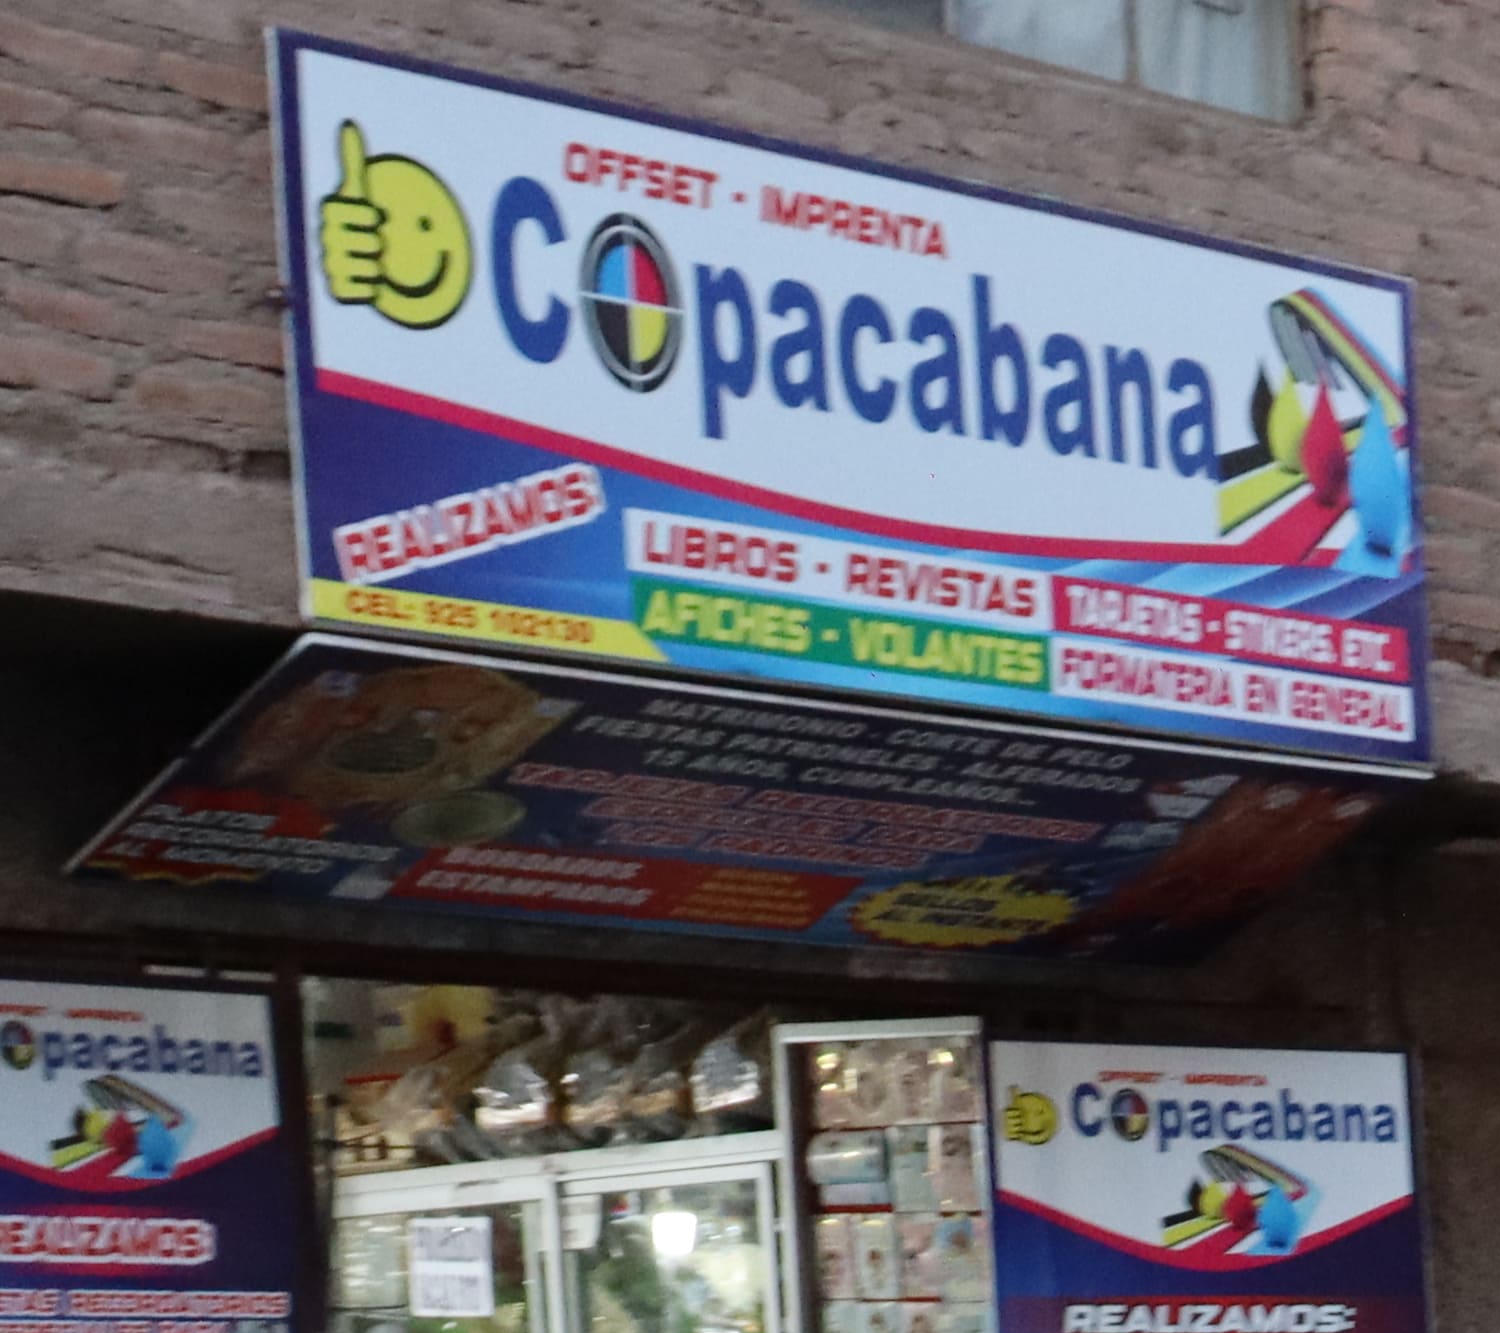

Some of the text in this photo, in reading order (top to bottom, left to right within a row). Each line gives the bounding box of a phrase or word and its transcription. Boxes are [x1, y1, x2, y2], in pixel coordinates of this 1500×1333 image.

[562, 142, 947, 260] OFFSET IMPRENTA
[490, 176, 1219, 478] Copacabana
[643, 521, 1037, 618] LIBROS REVISTAS
[344, 590, 596, 644] CEL: 925 102130
[642, 589, 1044, 684] AFICHES VOLANTES
[1066, 585, 1203, 643] TARJETAS
[1246, 673, 1280, 714] EN
[1291, 680, 1407, 734] GENERAL
[0, 1018, 266, 1081] opacabana
[1069, 1081, 1399, 1152] Copacabana
